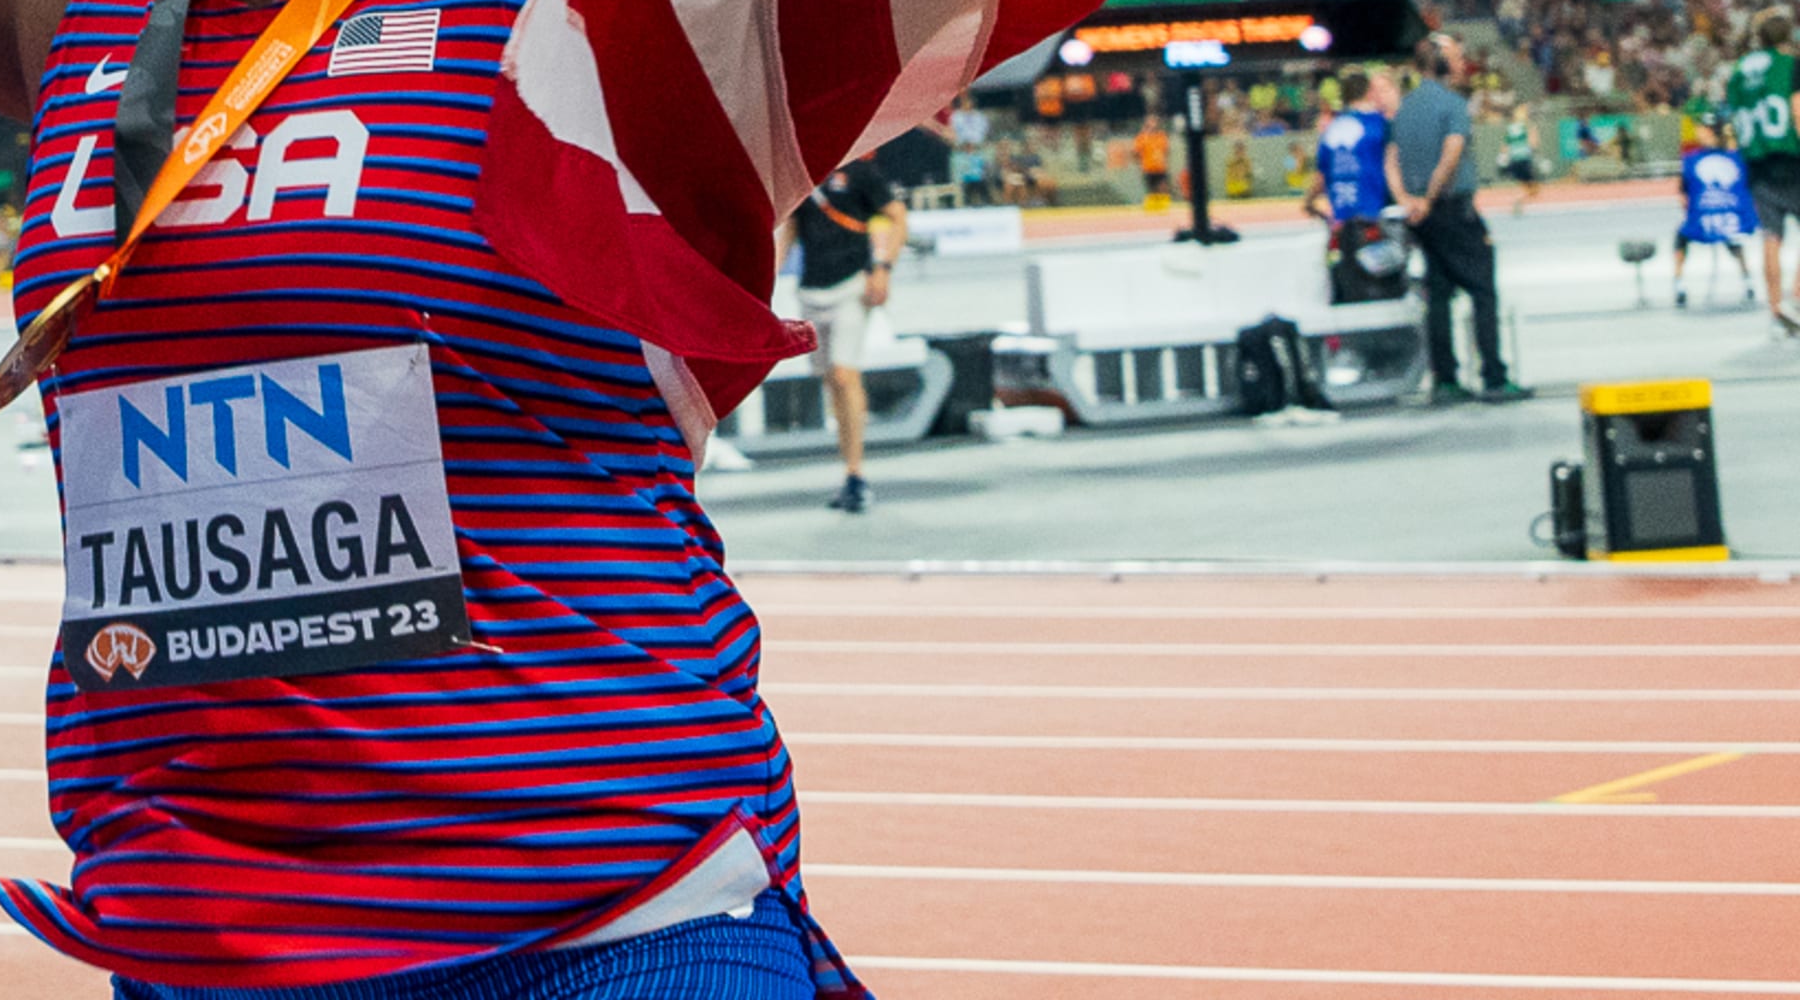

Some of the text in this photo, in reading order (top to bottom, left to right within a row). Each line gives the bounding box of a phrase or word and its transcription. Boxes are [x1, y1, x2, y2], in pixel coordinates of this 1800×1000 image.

[118, 363, 353, 489] NTN
[81, 494, 433, 610] TAUSAGA
[165, 602, 441, 662] BUDAPEST 23
